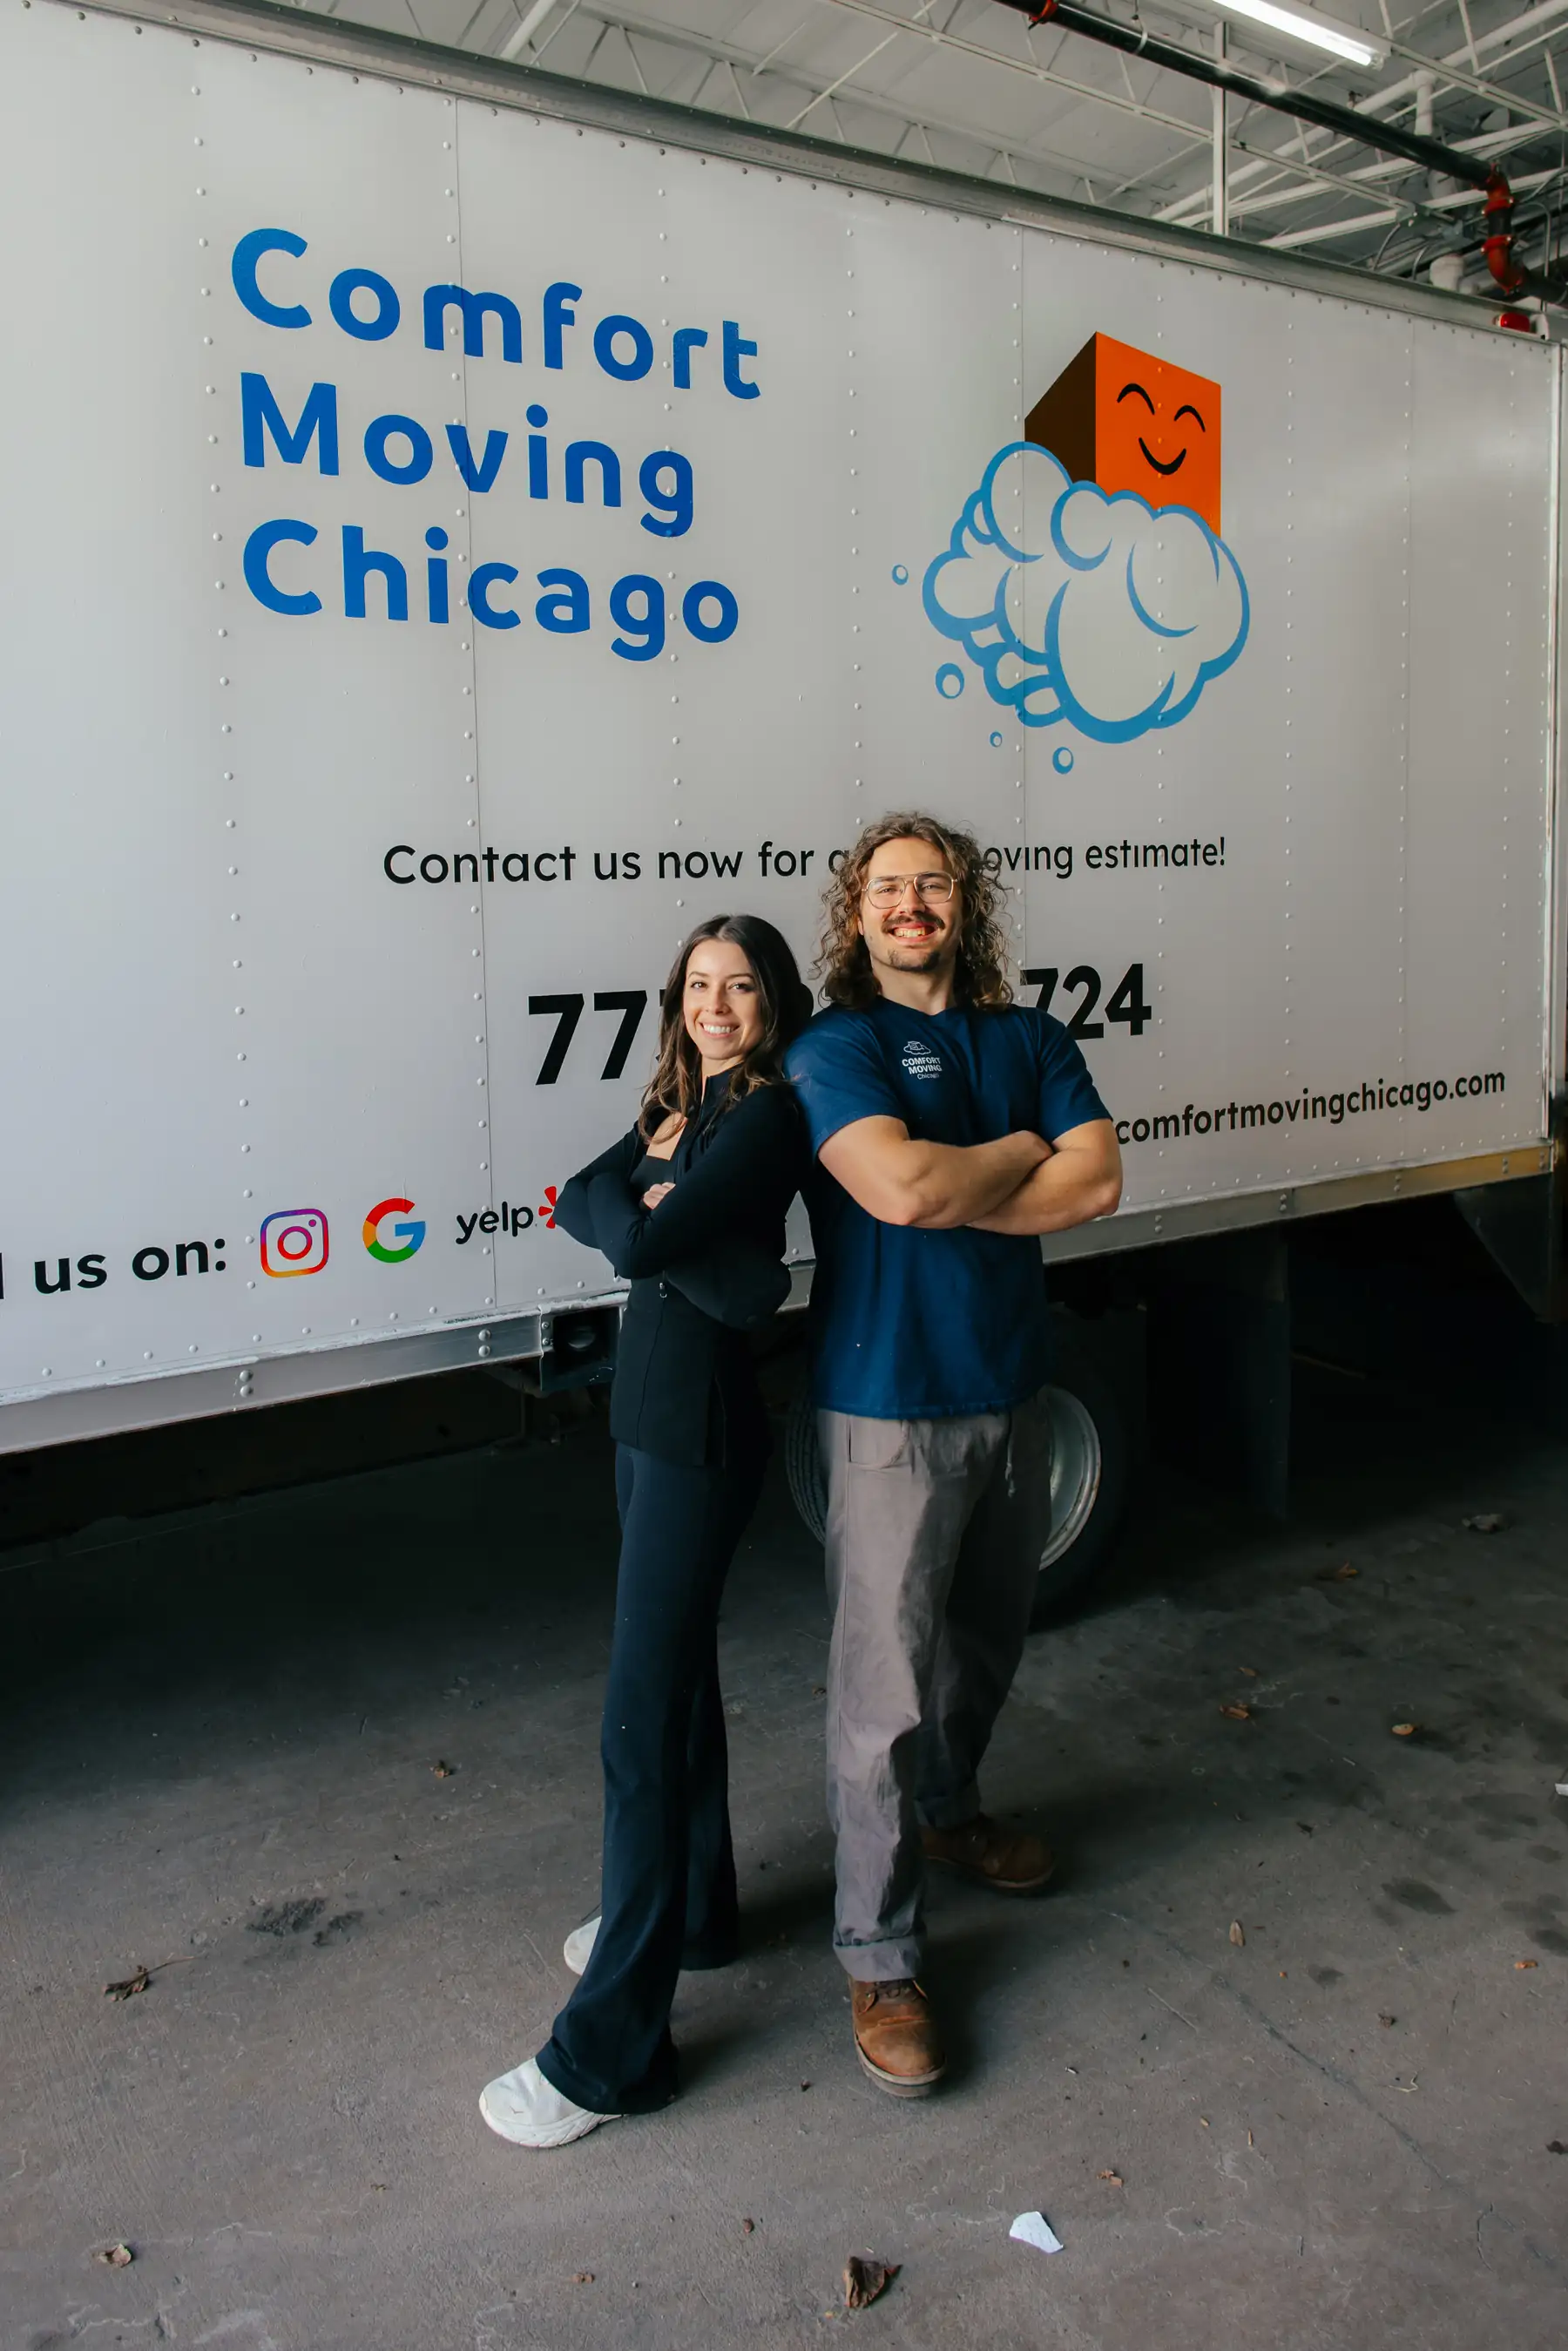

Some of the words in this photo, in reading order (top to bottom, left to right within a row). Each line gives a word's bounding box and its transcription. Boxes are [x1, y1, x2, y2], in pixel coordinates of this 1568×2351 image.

[231, 227, 760, 399] Comfort
[240, 372, 693, 538] Moving
[243, 518, 739, 661] Chicago
[383, 844, 577, 884] Contact
[594, 851, 641, 881] us
[659, 850, 743, 879] now
[758, 841, 814, 877] for
[983, 845, 1073, 879] oving
[1085, 837, 1226, 870] estimate!
[528, 989, 668, 1086] 77
[902, 1057, 941, 1067] COMFORT
[908, 1064, 942, 1074] MOVING
[1115, 1072, 1505, 1145] comfortmovingchicago.com
[455, 1201, 534, 1245] yelp
[34, 1253, 108, 1294] us
[132, 1238, 226, 1282] on:
